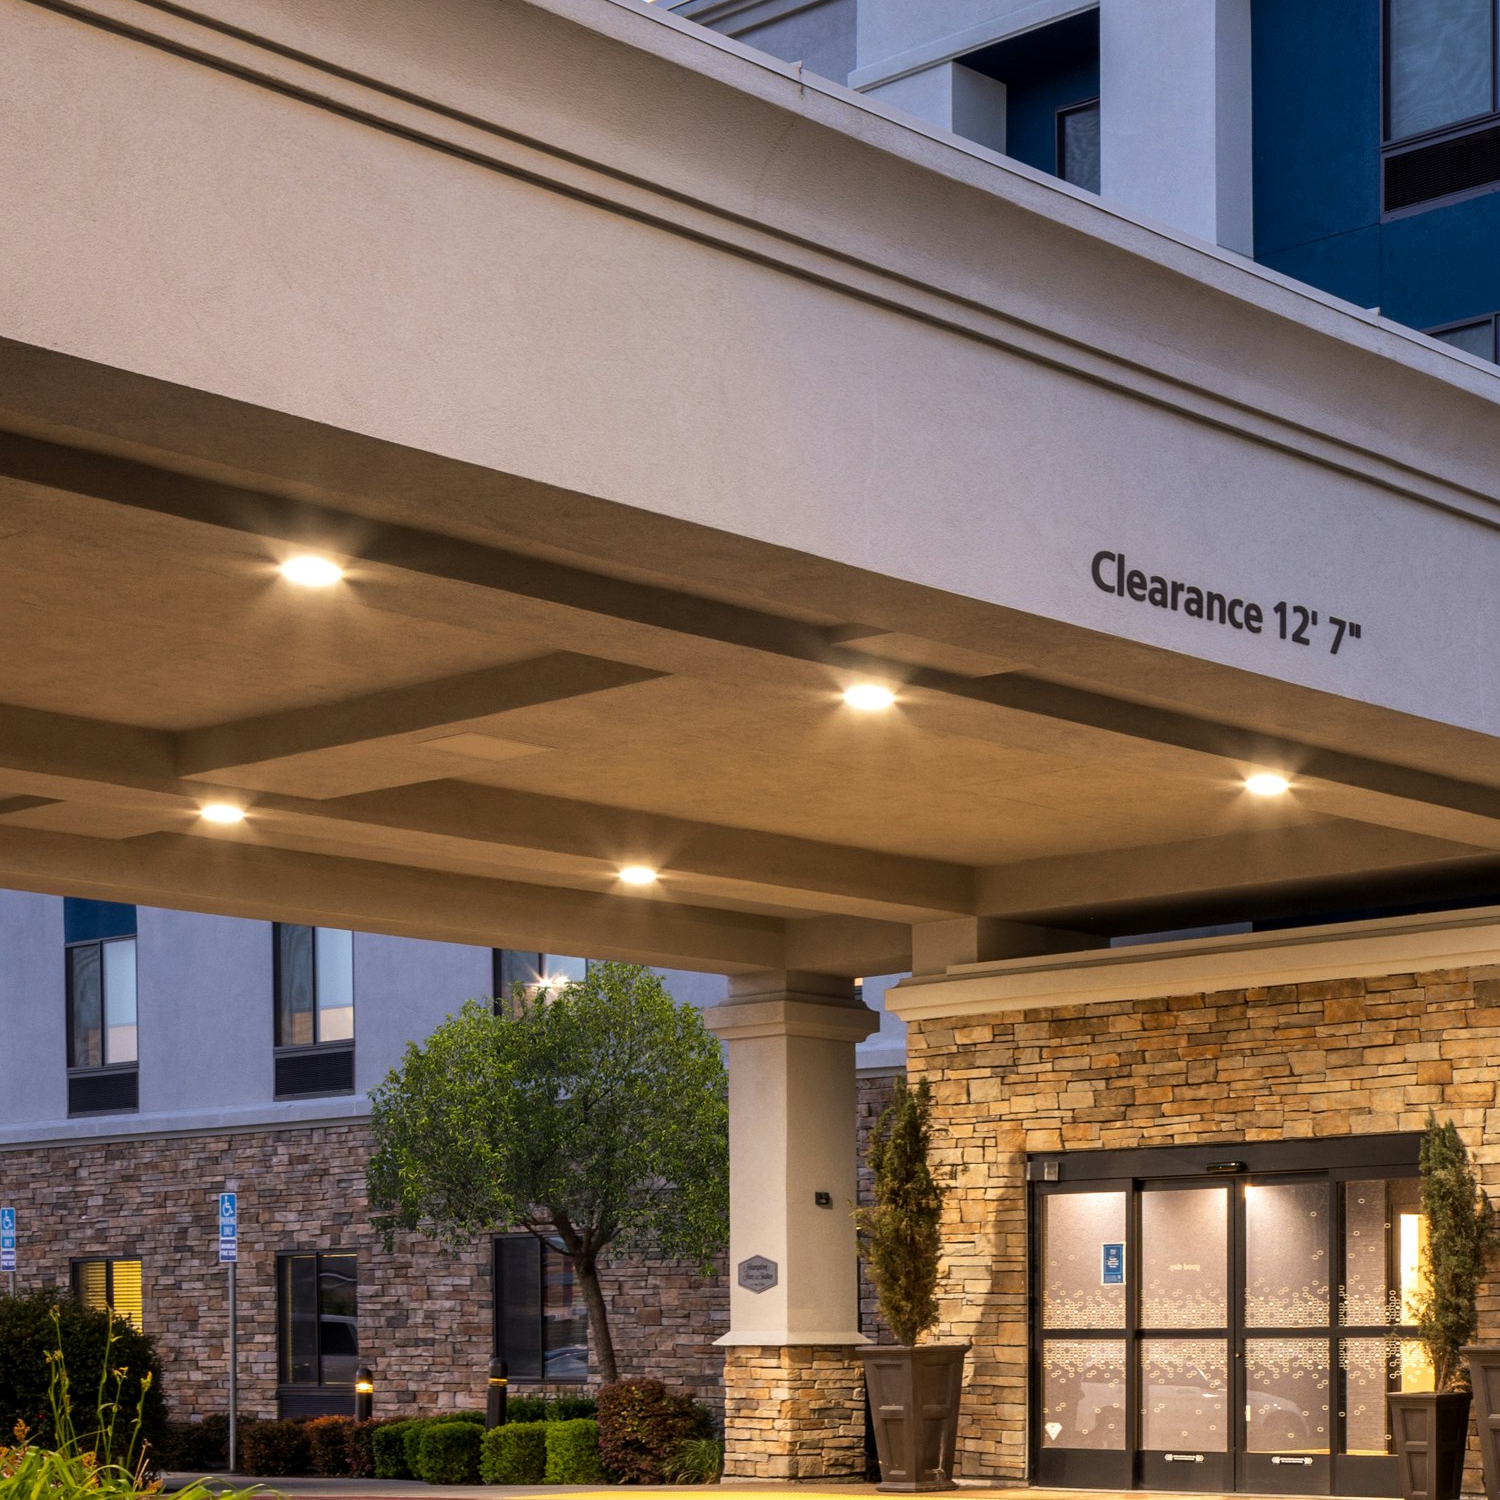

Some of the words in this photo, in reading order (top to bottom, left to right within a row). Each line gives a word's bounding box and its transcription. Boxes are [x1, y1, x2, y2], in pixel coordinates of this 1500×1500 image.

[1091, 550, 1264, 634] Clearance
[1273, 601, 1318, 646] 12'
[1329, 616, 1362, 655] 7"
